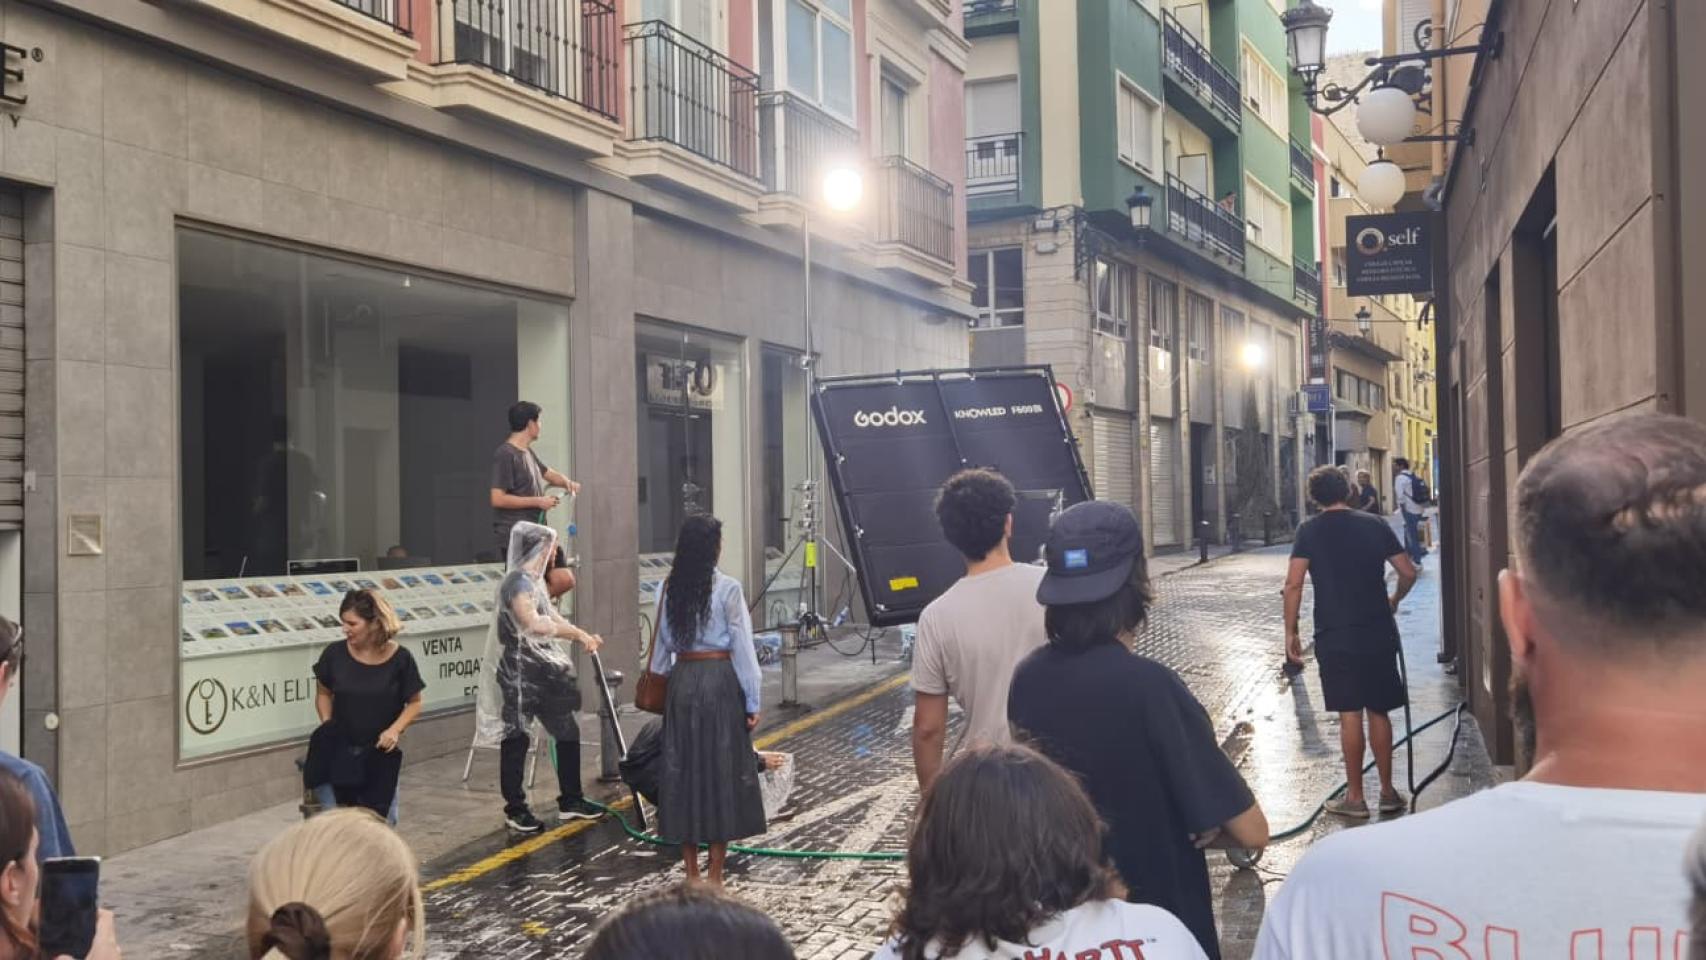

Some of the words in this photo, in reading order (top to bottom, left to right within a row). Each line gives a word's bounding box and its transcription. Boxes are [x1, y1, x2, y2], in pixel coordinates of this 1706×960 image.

[854, 406, 927, 427] Godox
[422, 636, 463, 656] VENTA
[439, 657, 484, 679] ПРОДА
[231, 682, 277, 711] K&N
